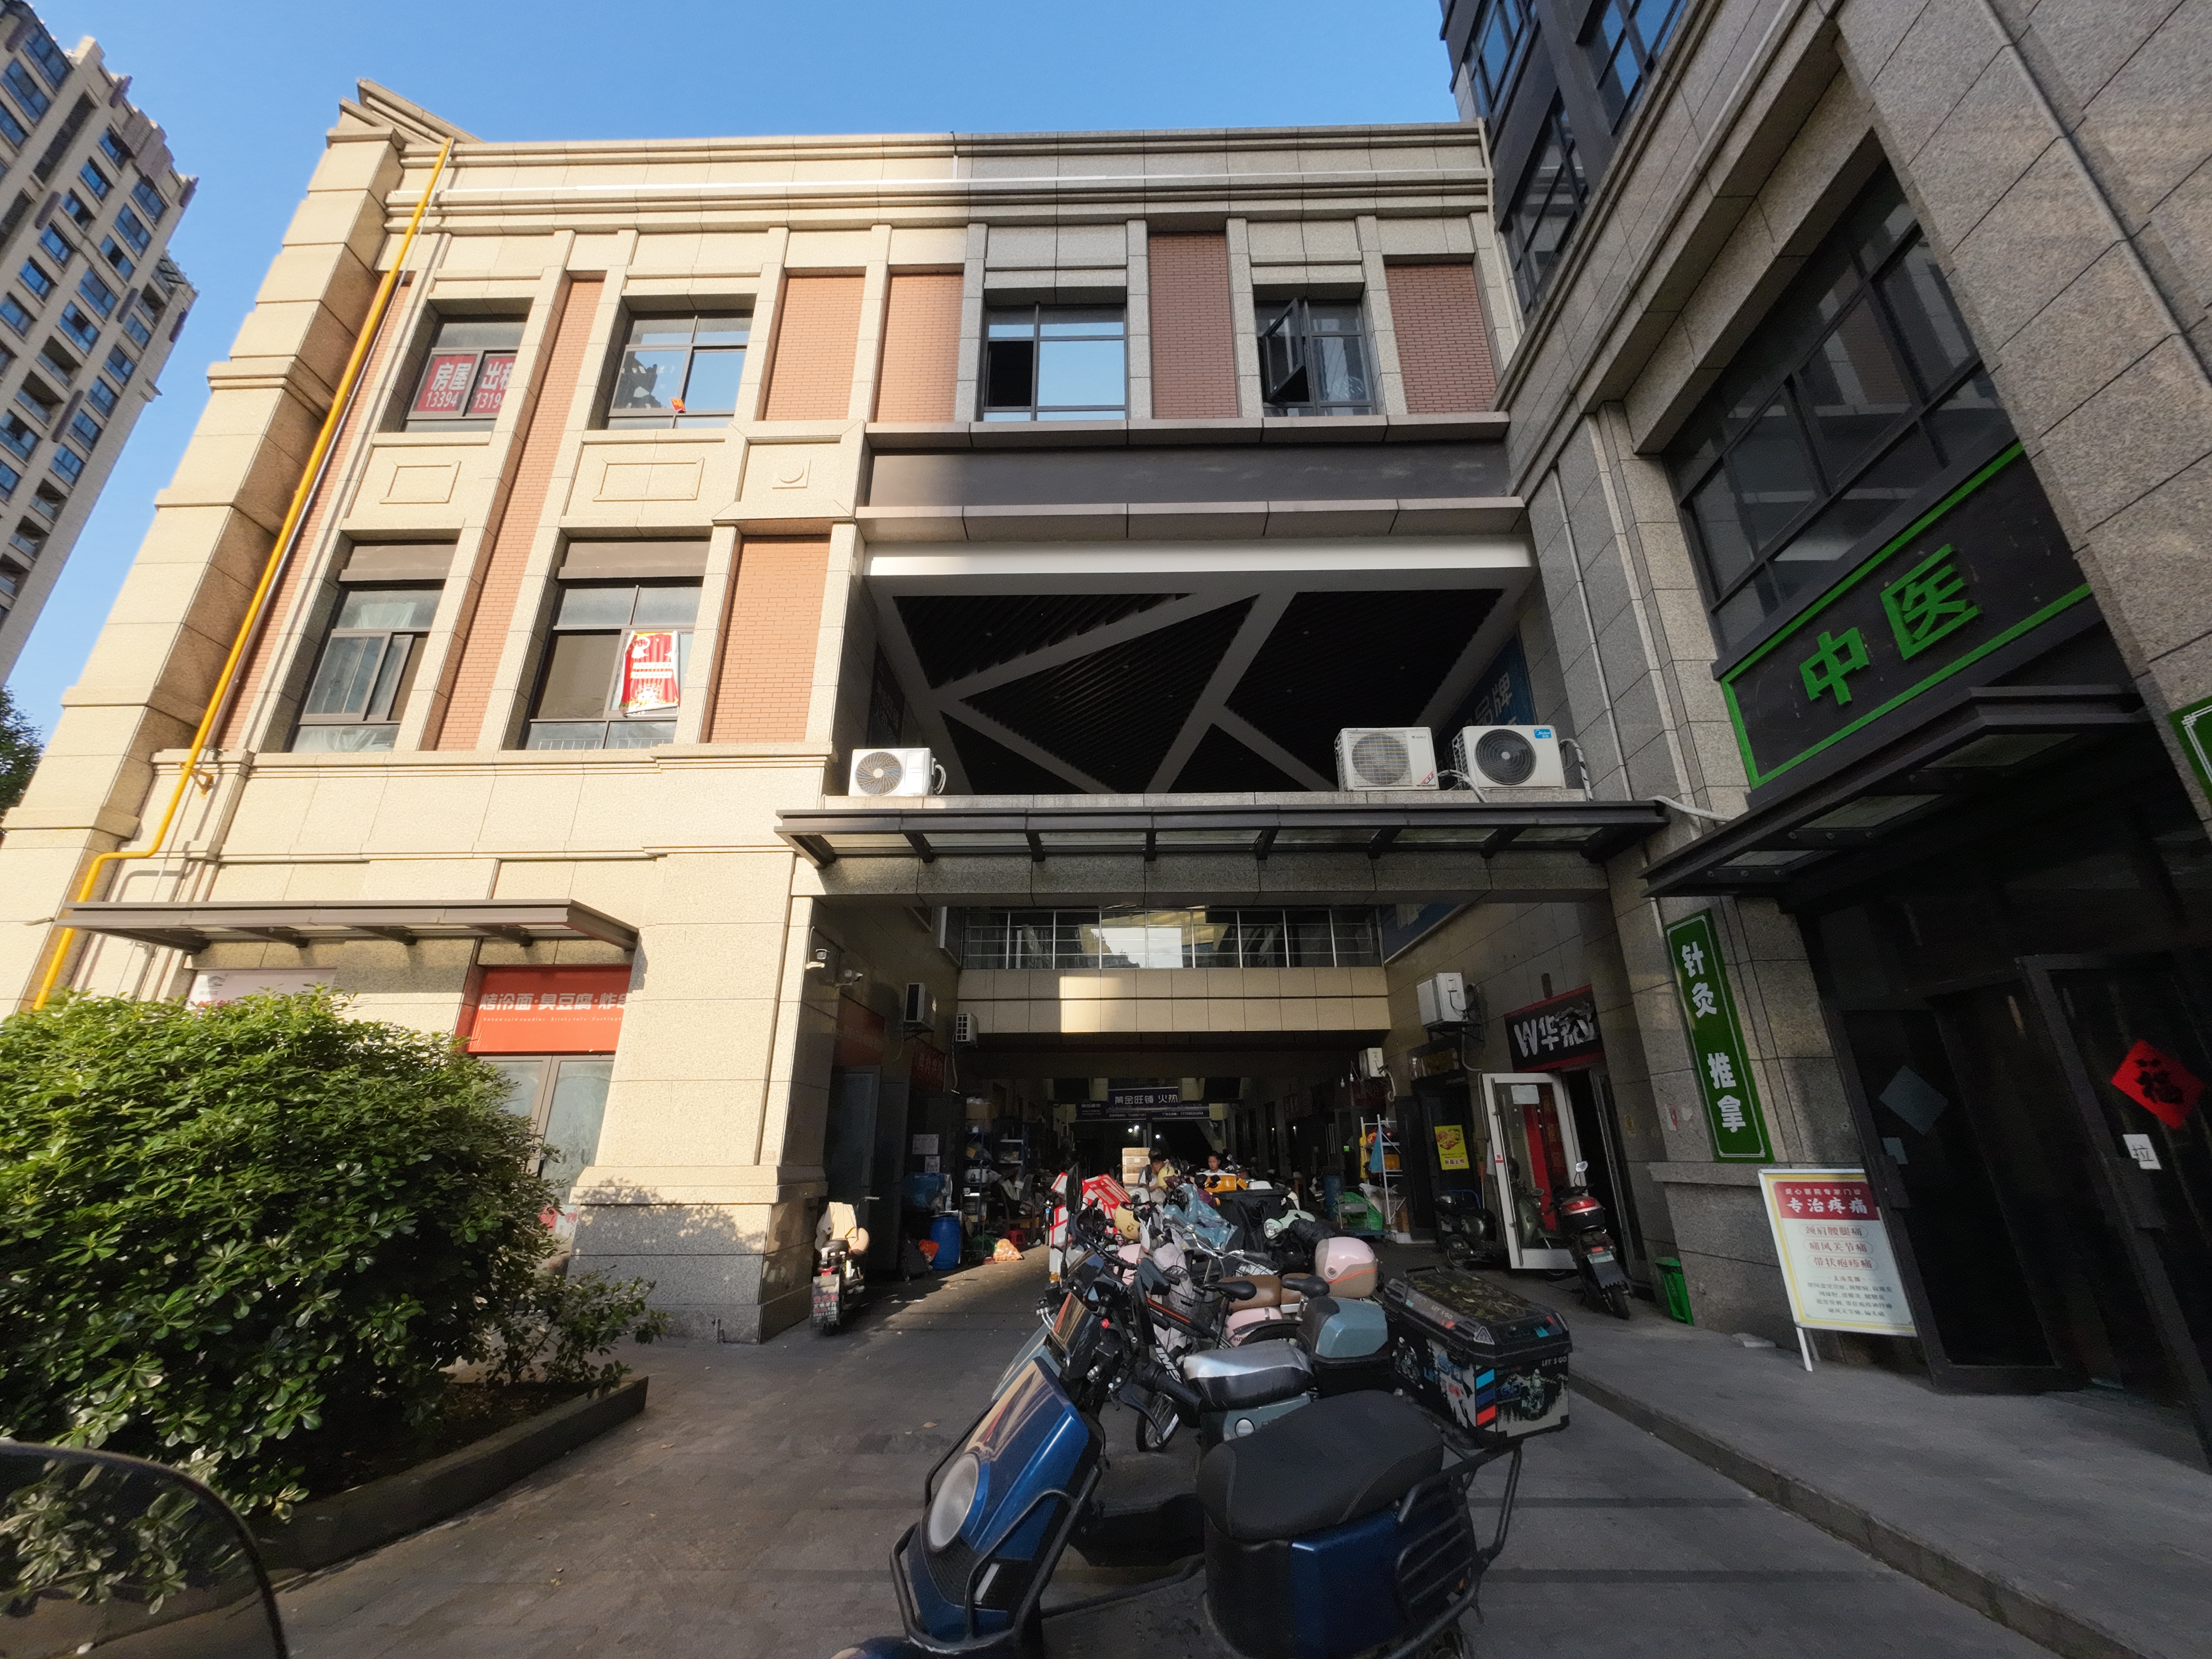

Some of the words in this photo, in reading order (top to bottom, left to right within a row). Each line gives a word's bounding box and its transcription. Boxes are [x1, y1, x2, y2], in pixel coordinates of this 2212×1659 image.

[431, 363, 472, 391] 房屋
[425, 391, 460, 408] 13394
[474, 392, 504, 409] 1319
[1798, 542, 1983, 706] 中医
[1682, 941, 1717, 1019] 针灸
[1707, 1052, 1746, 1133] 推拿
[1158, 1094, 1179, 1103] 火热
[2132, 1144, 2154, 1162] 拉
[1786, 1197, 1867, 1214] 专治疼痛
[1805, 1225, 1863, 1237] 颈肩腰腿痛
[1809, 1241, 1867, 1253] 痛风关节痛
